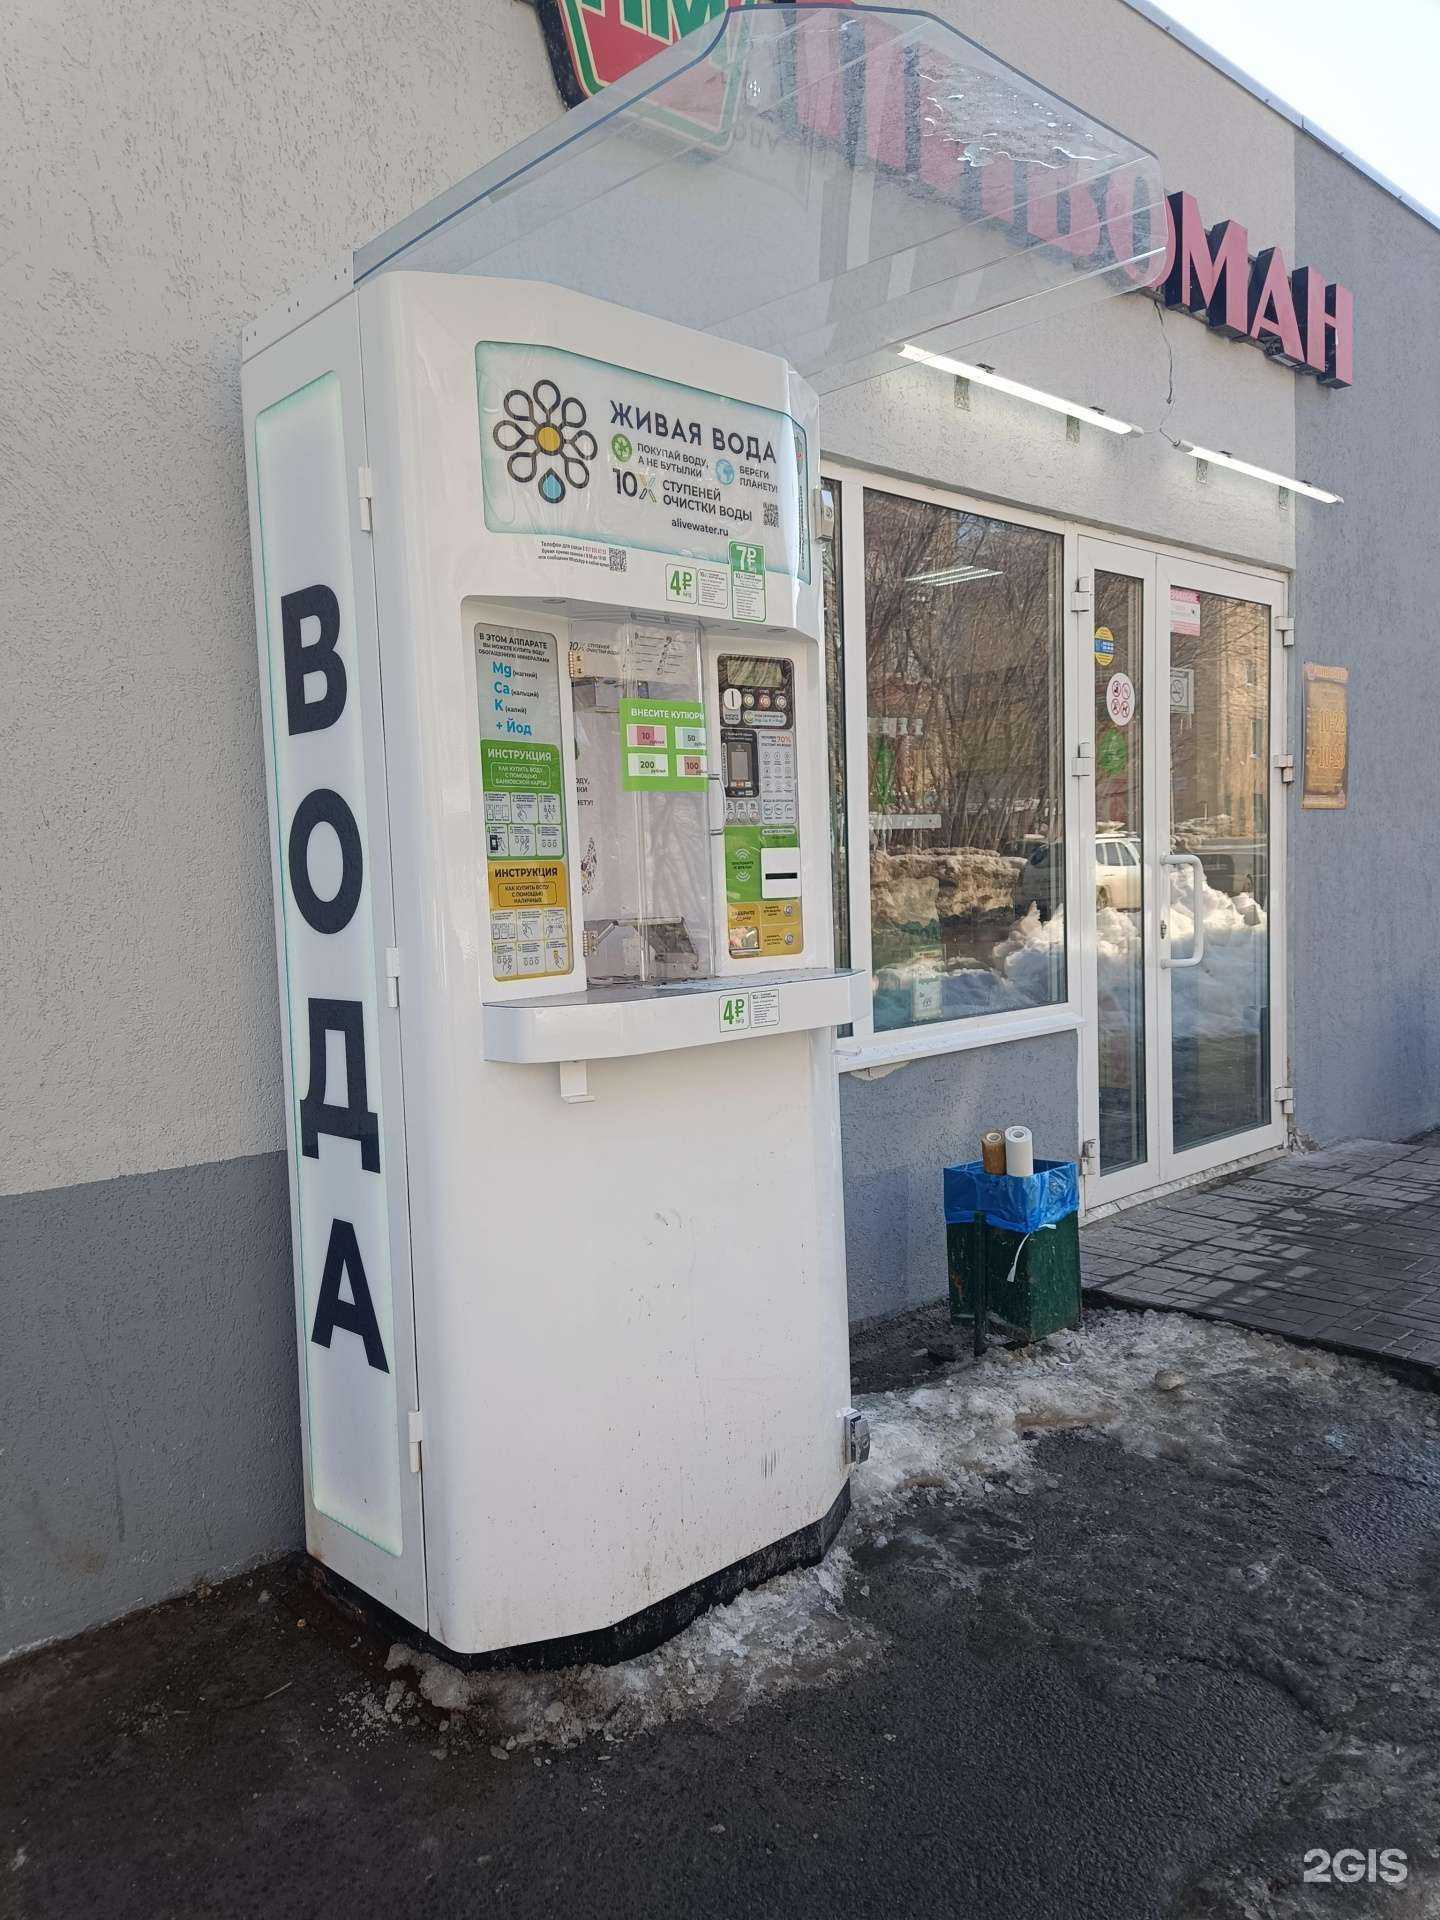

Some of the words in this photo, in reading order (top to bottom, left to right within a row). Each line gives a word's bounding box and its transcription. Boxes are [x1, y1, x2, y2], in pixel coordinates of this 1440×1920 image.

[610, 399, 702, 446] ЖИВАЯ
[712, 427, 777, 464] ВОДА
[637, 442, 681, 462] ПОКУПАЙ
[683, 455, 709, 469] ВОДУ,
[646, 457, 659, 468] НЕ
[660, 460, 702, 478] БУТЫЛКИ
[739, 465, 770, 480] БЕРЕГИ
[662, 479, 721, 502] СТУПЕНЕЙ
[739, 477, 778, 494] ПЛАНЕТУ!
[663, 494, 717, 516] ОЧИСТКИ
[719, 504, 752, 522] ВОДЫ
[671, 517, 729, 537] alivewater.ru
[485, 633, 507, 643] ЭТОМ
[509, 637, 548, 650] АППАРАТЕ
[492, 661, 512, 678] Mg
[494, 681, 510, 695] Ca
[631, 707, 670, 718] ВНЕСИТЕ
[506, 717, 532, 736] Йод
[641, 732, 651, 740] 10
[687, 734, 696, 742] 50
[487, 748, 552, 763] ИНСТРУКЦИЯ
[640, 760, 655, 769] 200
[686, 762, 699, 770] 100
[494, 867, 558, 879] ИНСТРУКЦИЯ
[280, 583, 390, 1374] ВОДА
